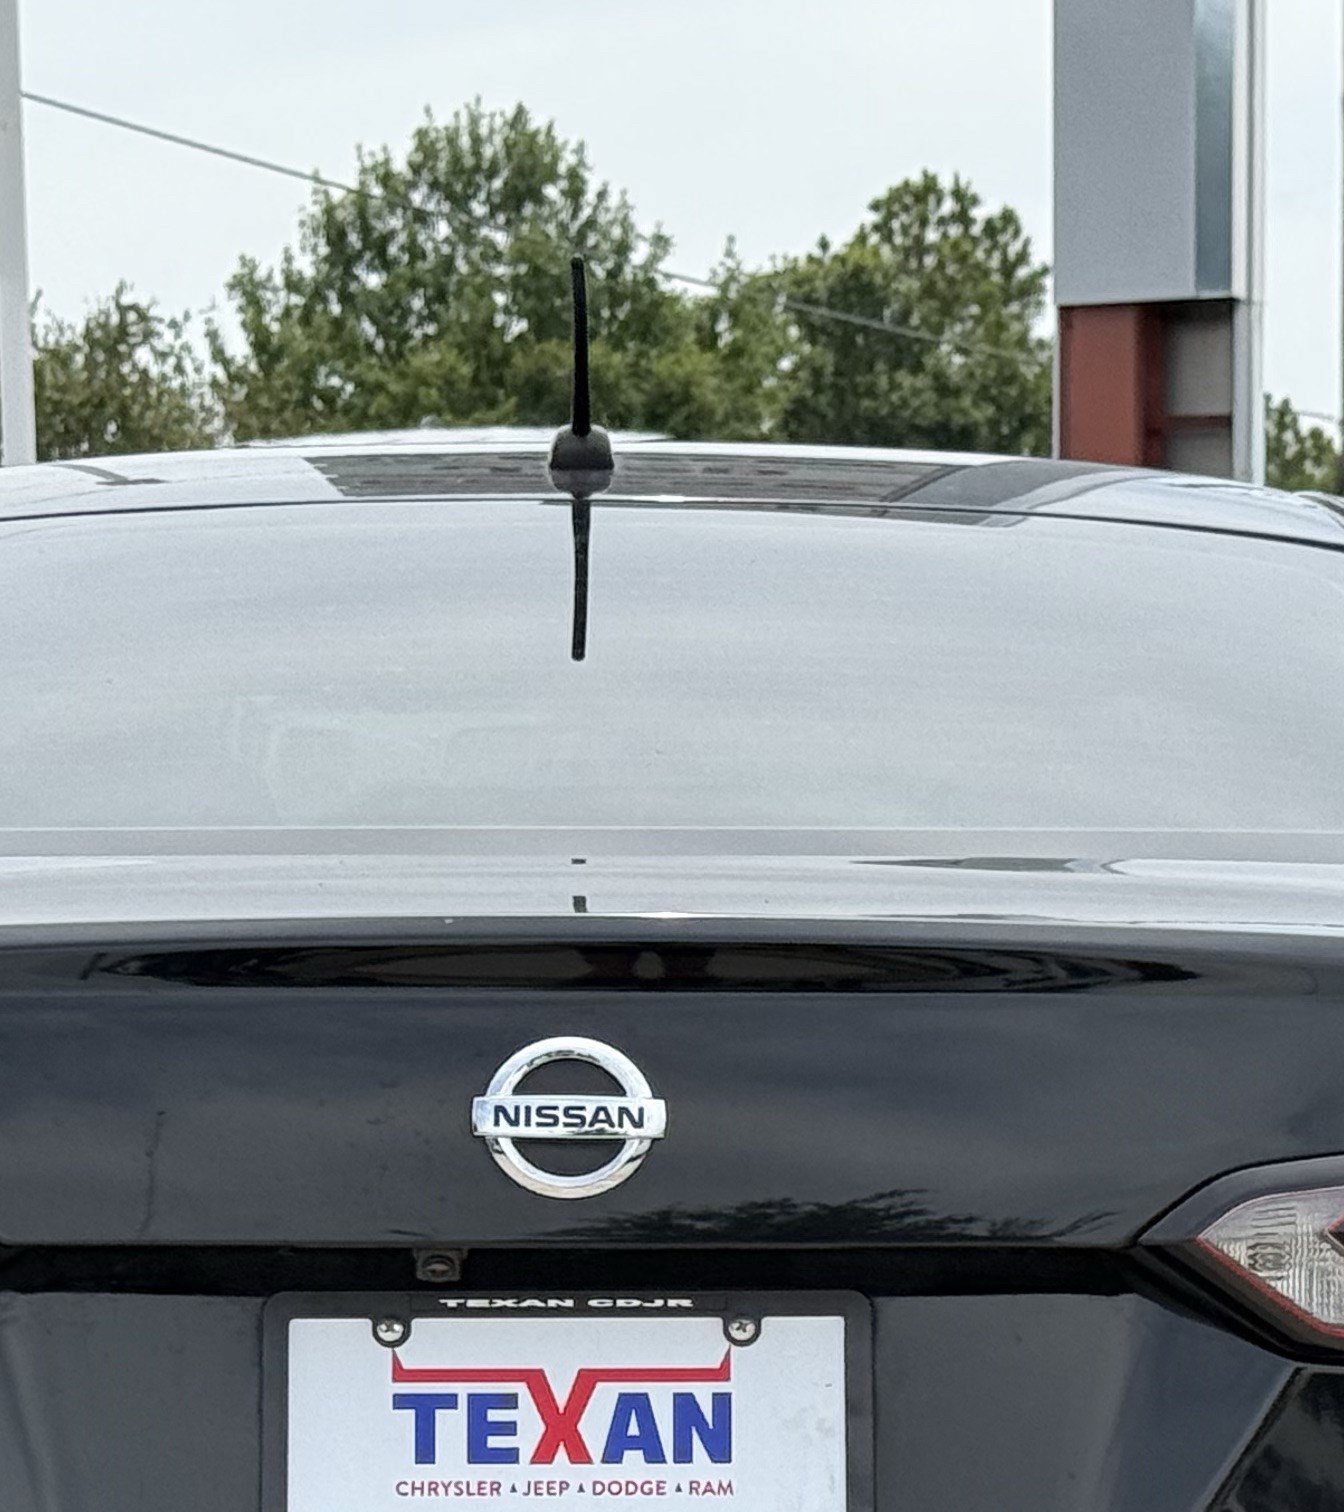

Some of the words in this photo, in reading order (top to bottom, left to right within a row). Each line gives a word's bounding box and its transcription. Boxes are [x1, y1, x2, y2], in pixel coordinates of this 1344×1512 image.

[493, 1104, 645, 1130] NISSAN
[438, 1298, 575, 1308] TEXAN
[587, 1298, 695, 1308] CDJR
[392, 1368, 733, 1465] TEXAN
[395, 1480, 502, 1497] CHRYSLER
[522, 1480, 571, 1497] JEEP
[591, 1480, 668, 1497] DODGE
[688, 1480, 735, 1497] RAM
